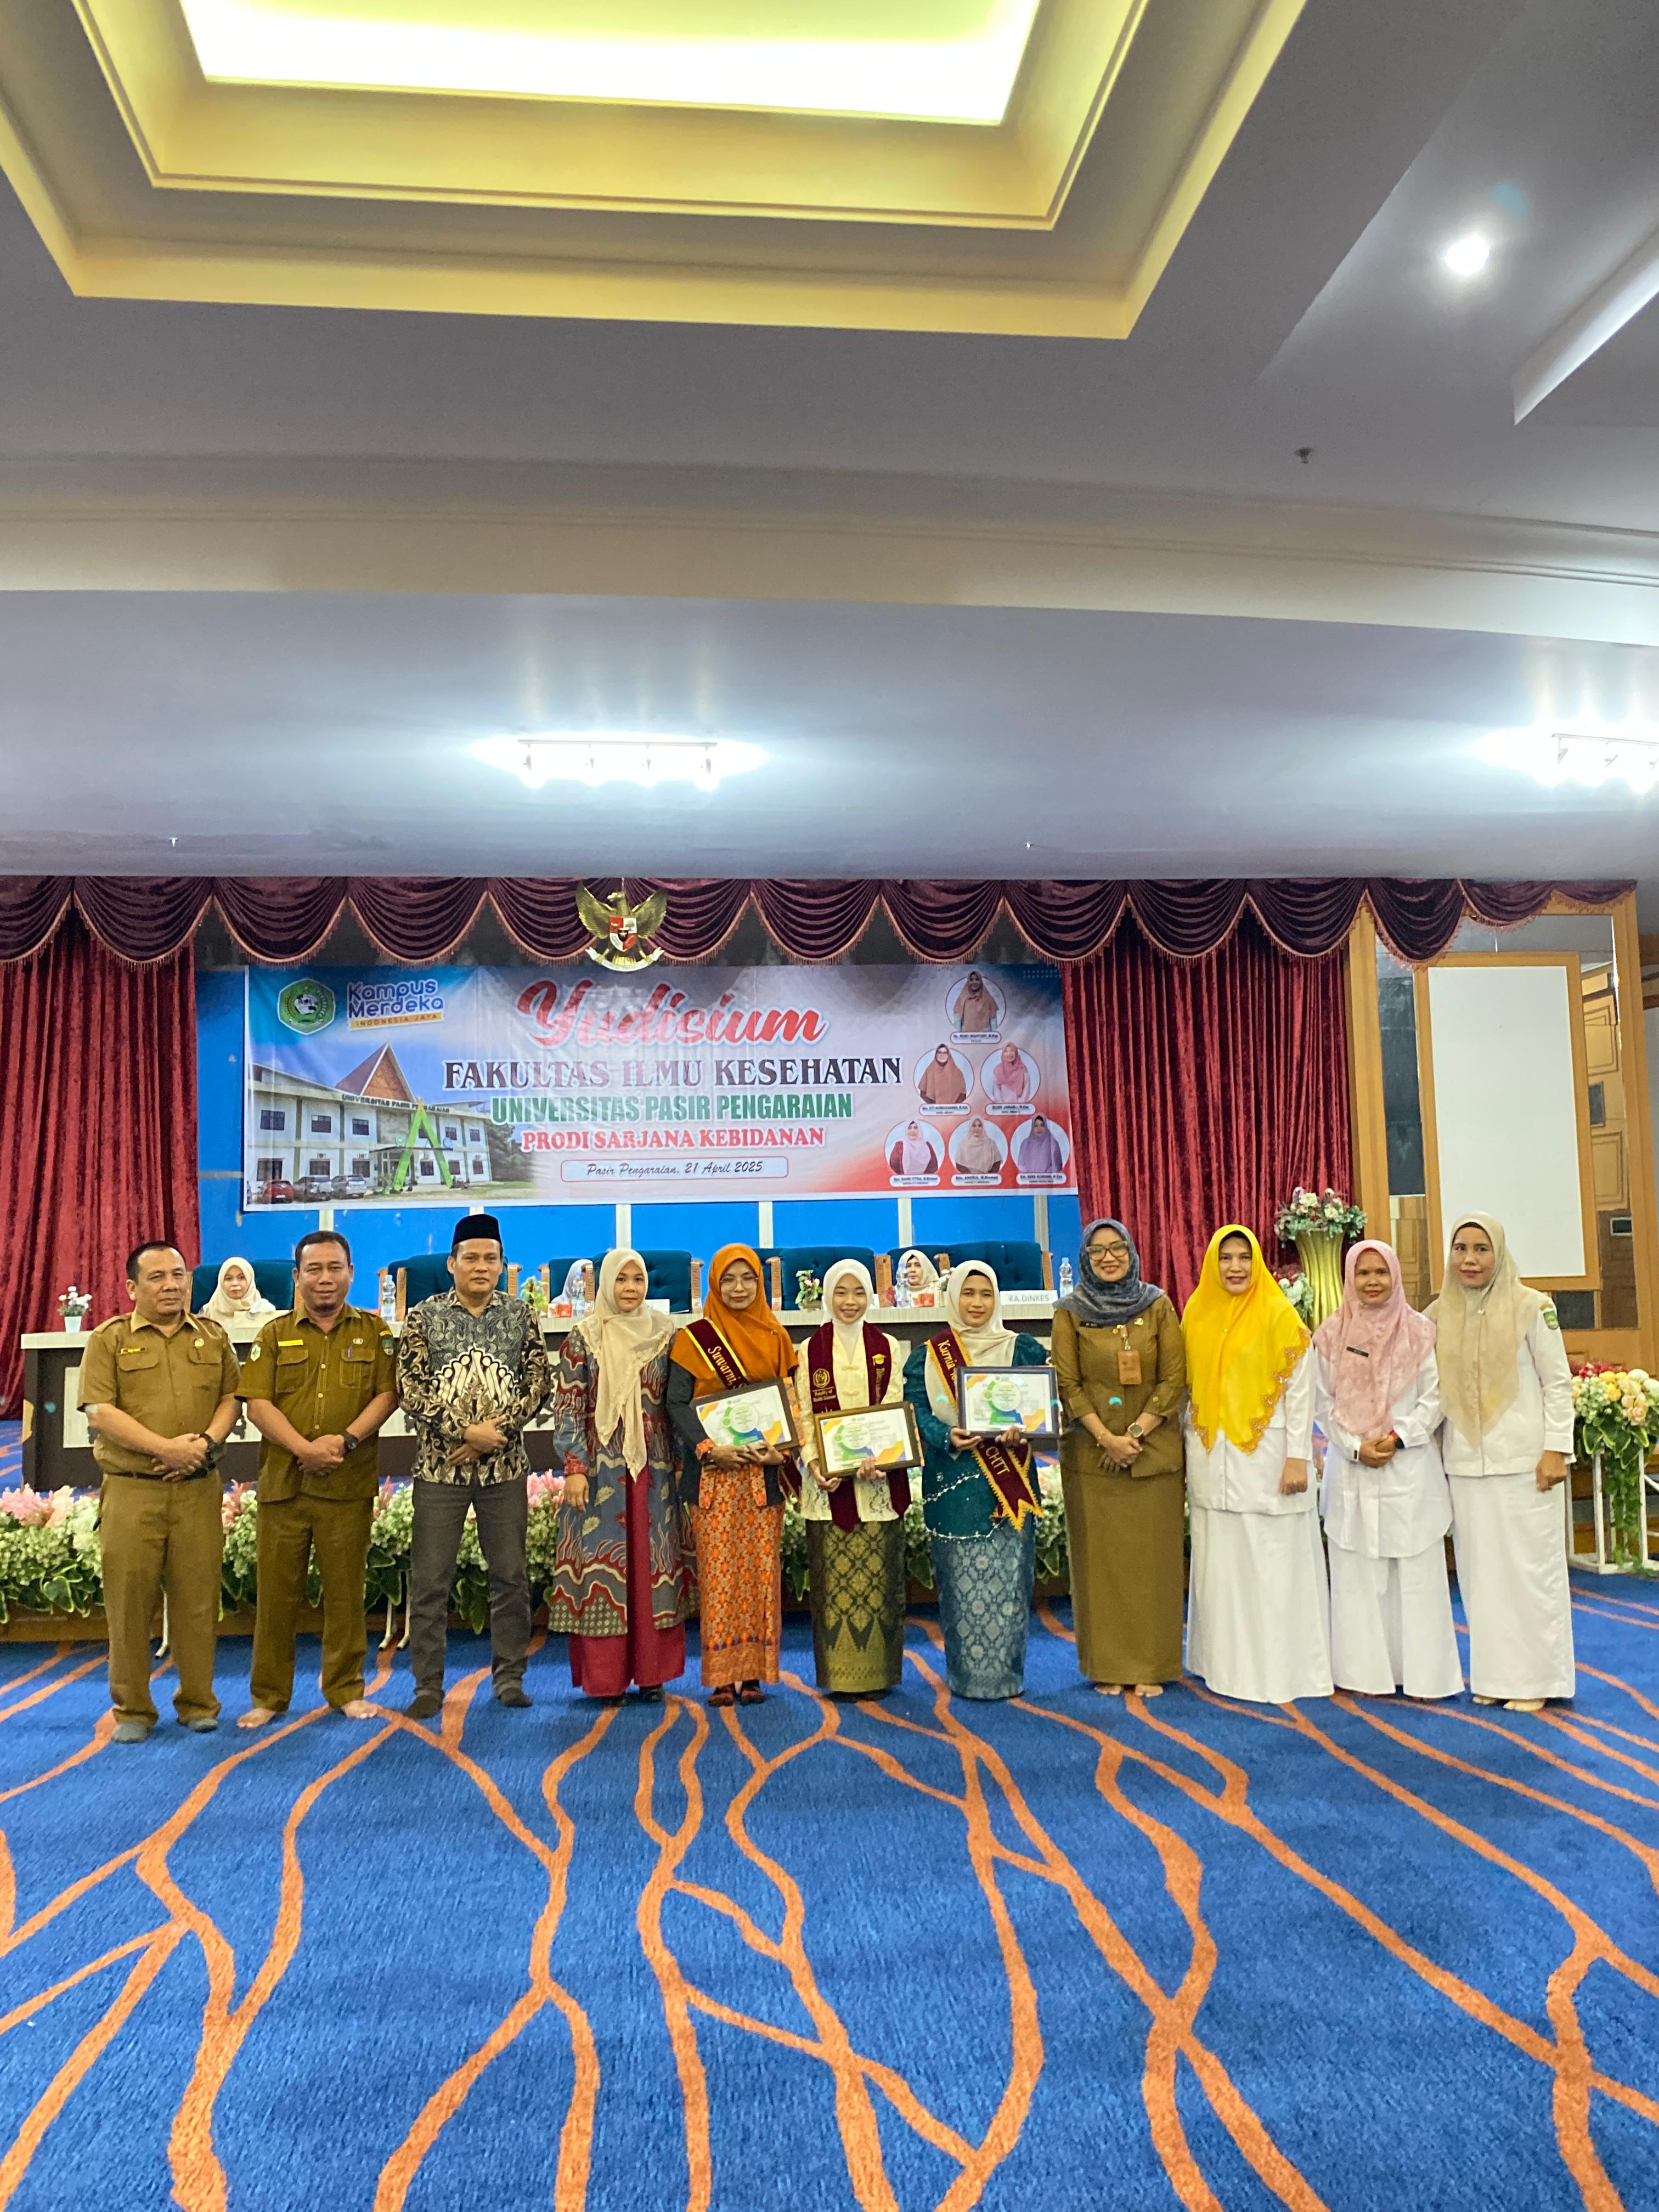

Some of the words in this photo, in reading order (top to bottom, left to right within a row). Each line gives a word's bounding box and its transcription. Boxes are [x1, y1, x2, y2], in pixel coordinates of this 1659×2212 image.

[348, 980, 437, 1000] Kampus
[348, 995, 444, 1018] Merdeka
[517, 979, 827, 1046] Yudisium
[356, 1017, 409, 1027] INDONESIA
[415, 1013, 438, 1022] JAYA
[444, 1060, 608, 1089] FAKULTAS
[623, 1060, 701, 1087] ILMU
[714, 1058, 901, 1086] KESEHATAN
[493, 1096, 640, 1122] UNIVERSITAS
[646, 1094, 710, 1121] PASIR
[716, 1093, 852, 1120] PENGARAIAN
[523, 1131, 589, 1149] PRODI
[595, 1129, 695, 1149] SARJANA
[699, 1127, 824, 1147] KEBIDANAN
[587, 1163, 616, 1176] Pasir
[619, 1162, 680, 1177] Pengaraian,
[684, 1163, 698, 1173] 21
[702, 1161, 731, 1175] April
[734, 1160, 763, 1172] 2025
[938, 1339, 957, 1370] Kurnia
